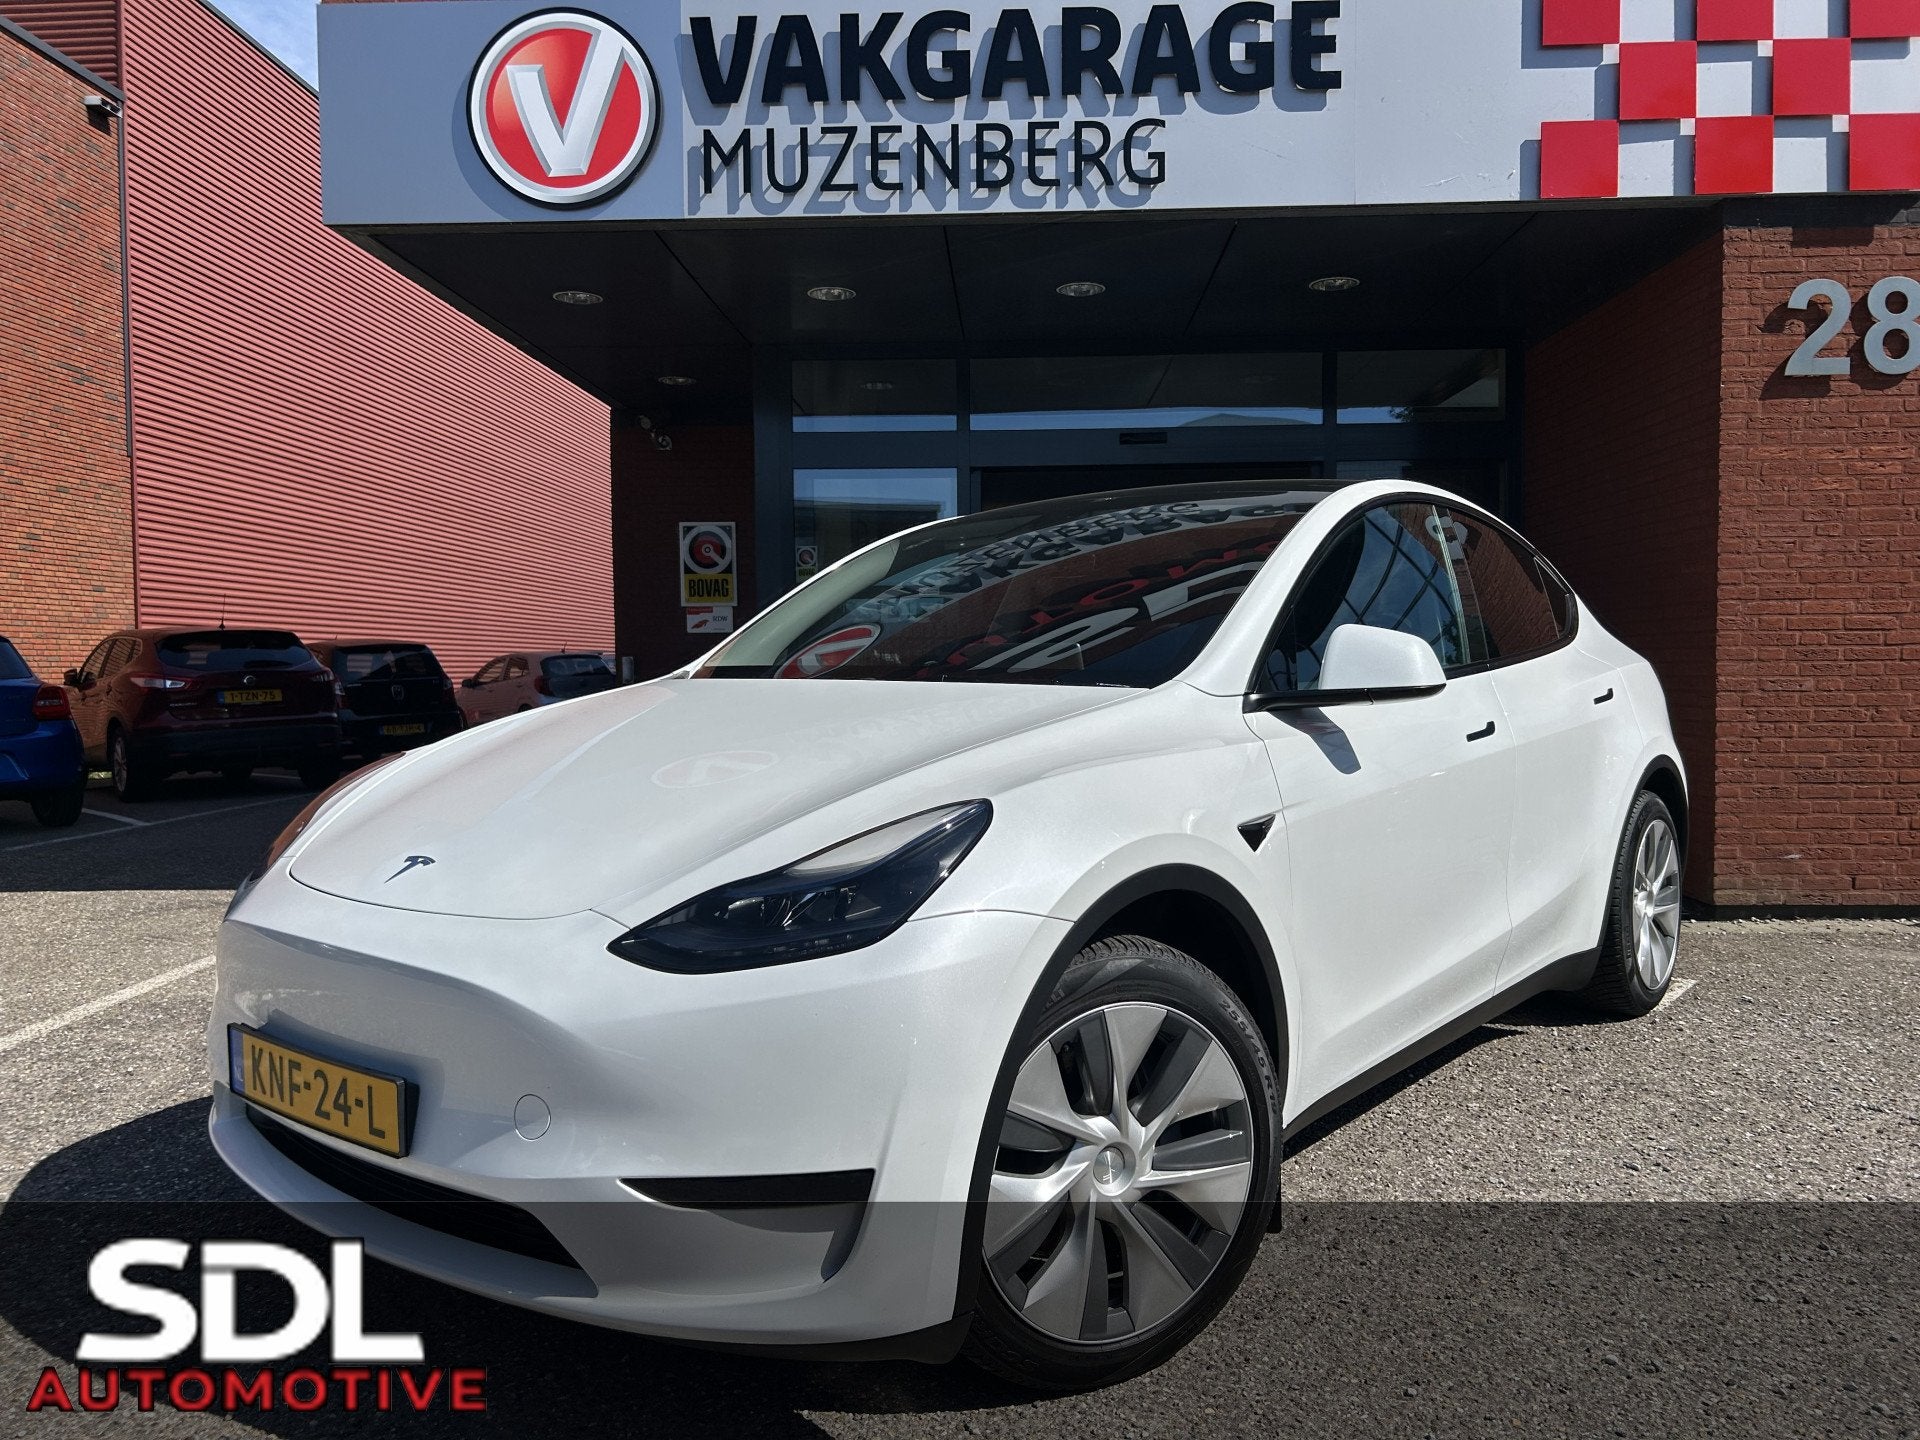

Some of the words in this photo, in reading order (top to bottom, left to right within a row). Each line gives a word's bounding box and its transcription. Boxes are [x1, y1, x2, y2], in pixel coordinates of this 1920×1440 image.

[690, 0, 1342, 104] VAKGARAGE
[703, 118, 1166, 194] MUZENBERG
[1784, 275, 1920, 376] 28
[688, 579, 729, 598] BOVAG
[251, 1044, 386, 1140] KNF-24-L
